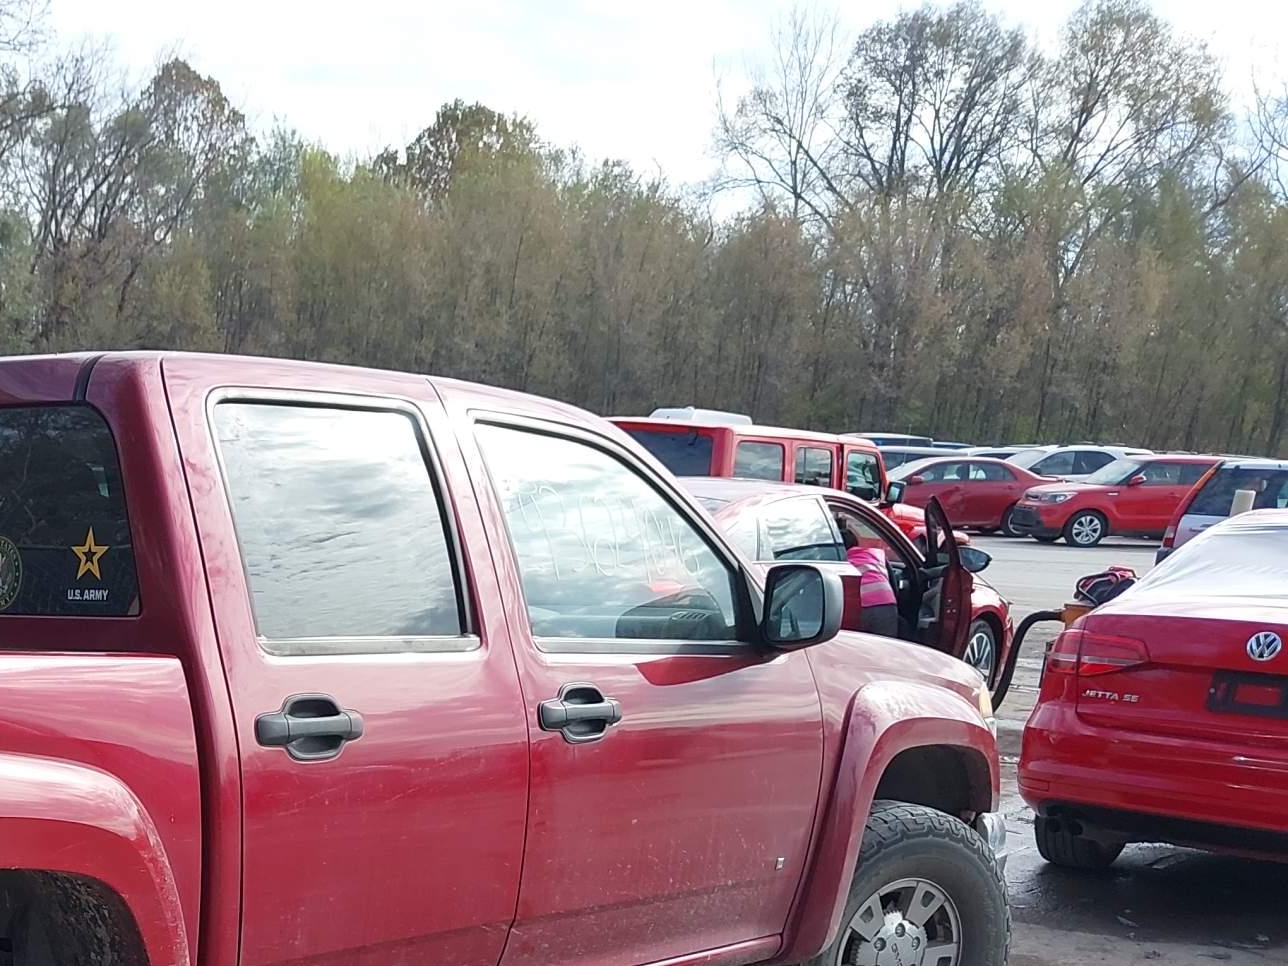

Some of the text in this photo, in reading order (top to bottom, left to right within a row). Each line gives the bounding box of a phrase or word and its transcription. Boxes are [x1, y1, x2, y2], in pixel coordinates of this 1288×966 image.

[67, 588, 109, 601] U.S. ARMY
[1081, 689, 1140, 703] JETTA SE
